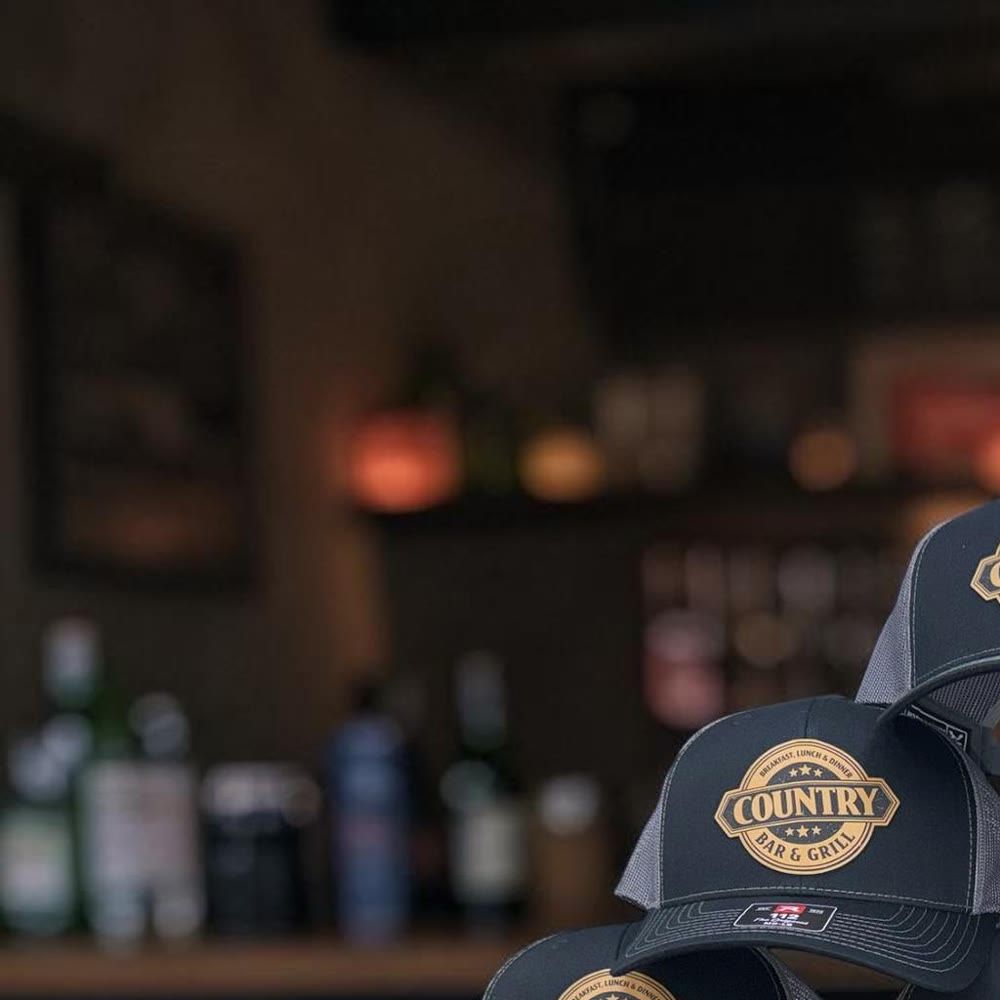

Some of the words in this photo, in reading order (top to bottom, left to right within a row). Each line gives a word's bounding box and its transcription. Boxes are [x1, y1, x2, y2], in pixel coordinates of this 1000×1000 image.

[797, 750, 821, 759] LUNCH
[830, 756, 853, 778] DINNER
[733, 787, 878, 825] COUNTRY
[755, 832, 785, 858] BAR
[790, 849, 800, 861] &
[807, 832, 855, 861] GRILL
[604, 979, 629, 988] LUNCH
